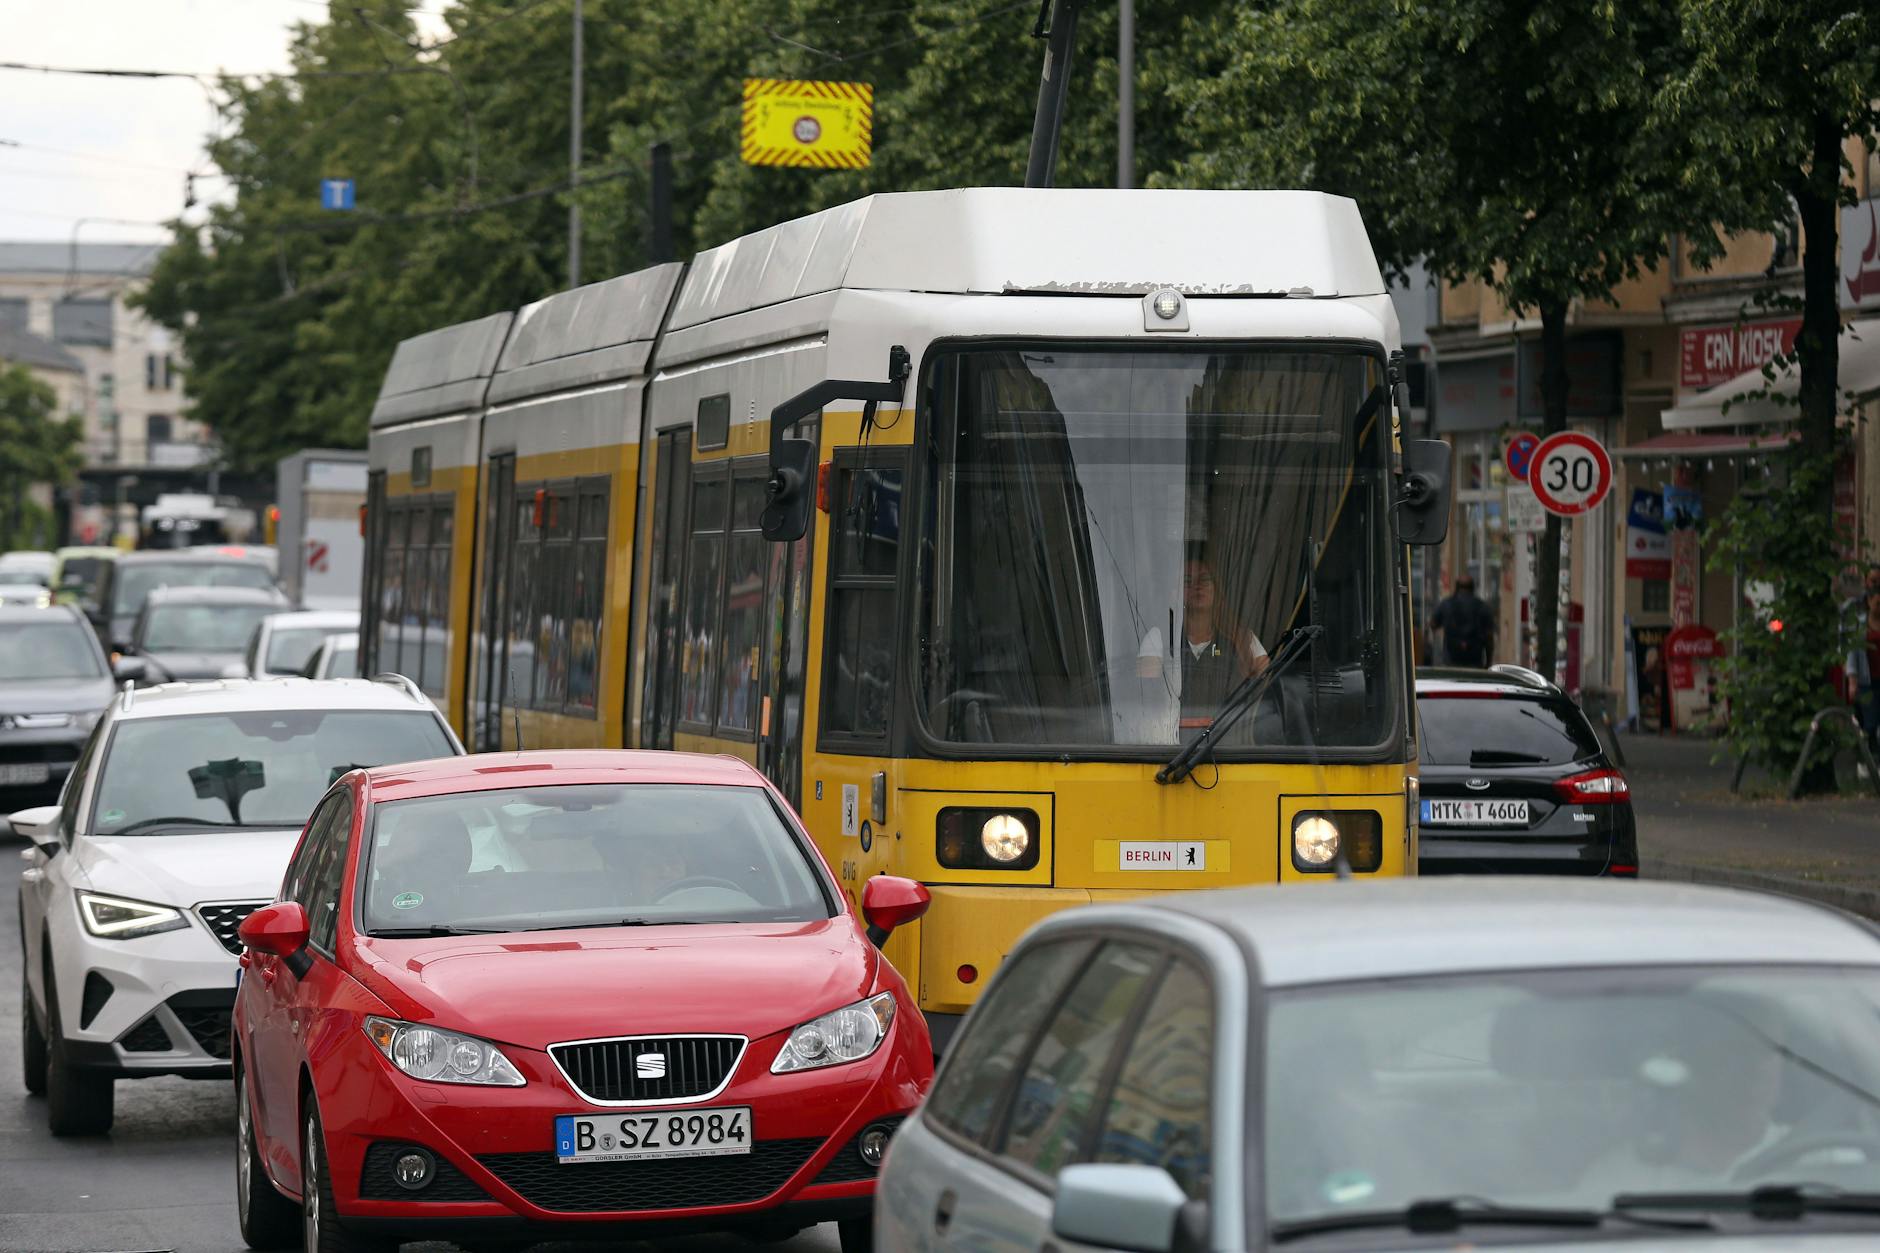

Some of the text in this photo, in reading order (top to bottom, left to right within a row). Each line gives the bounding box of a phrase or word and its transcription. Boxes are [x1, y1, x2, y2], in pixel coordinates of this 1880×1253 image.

[1703, 331, 1734, 371] CAN
[1546, 456, 1593, 492] 30
[1432, 802, 1462, 820] MTK
[1474, 802, 1484, 819] T
[1488, 802, 1527, 819] 4606
[1126, 850, 1171, 862] BERLIN
[842, 860, 857, 881] BVG
[562, 1113, 745, 1151] D B SZ 8984
